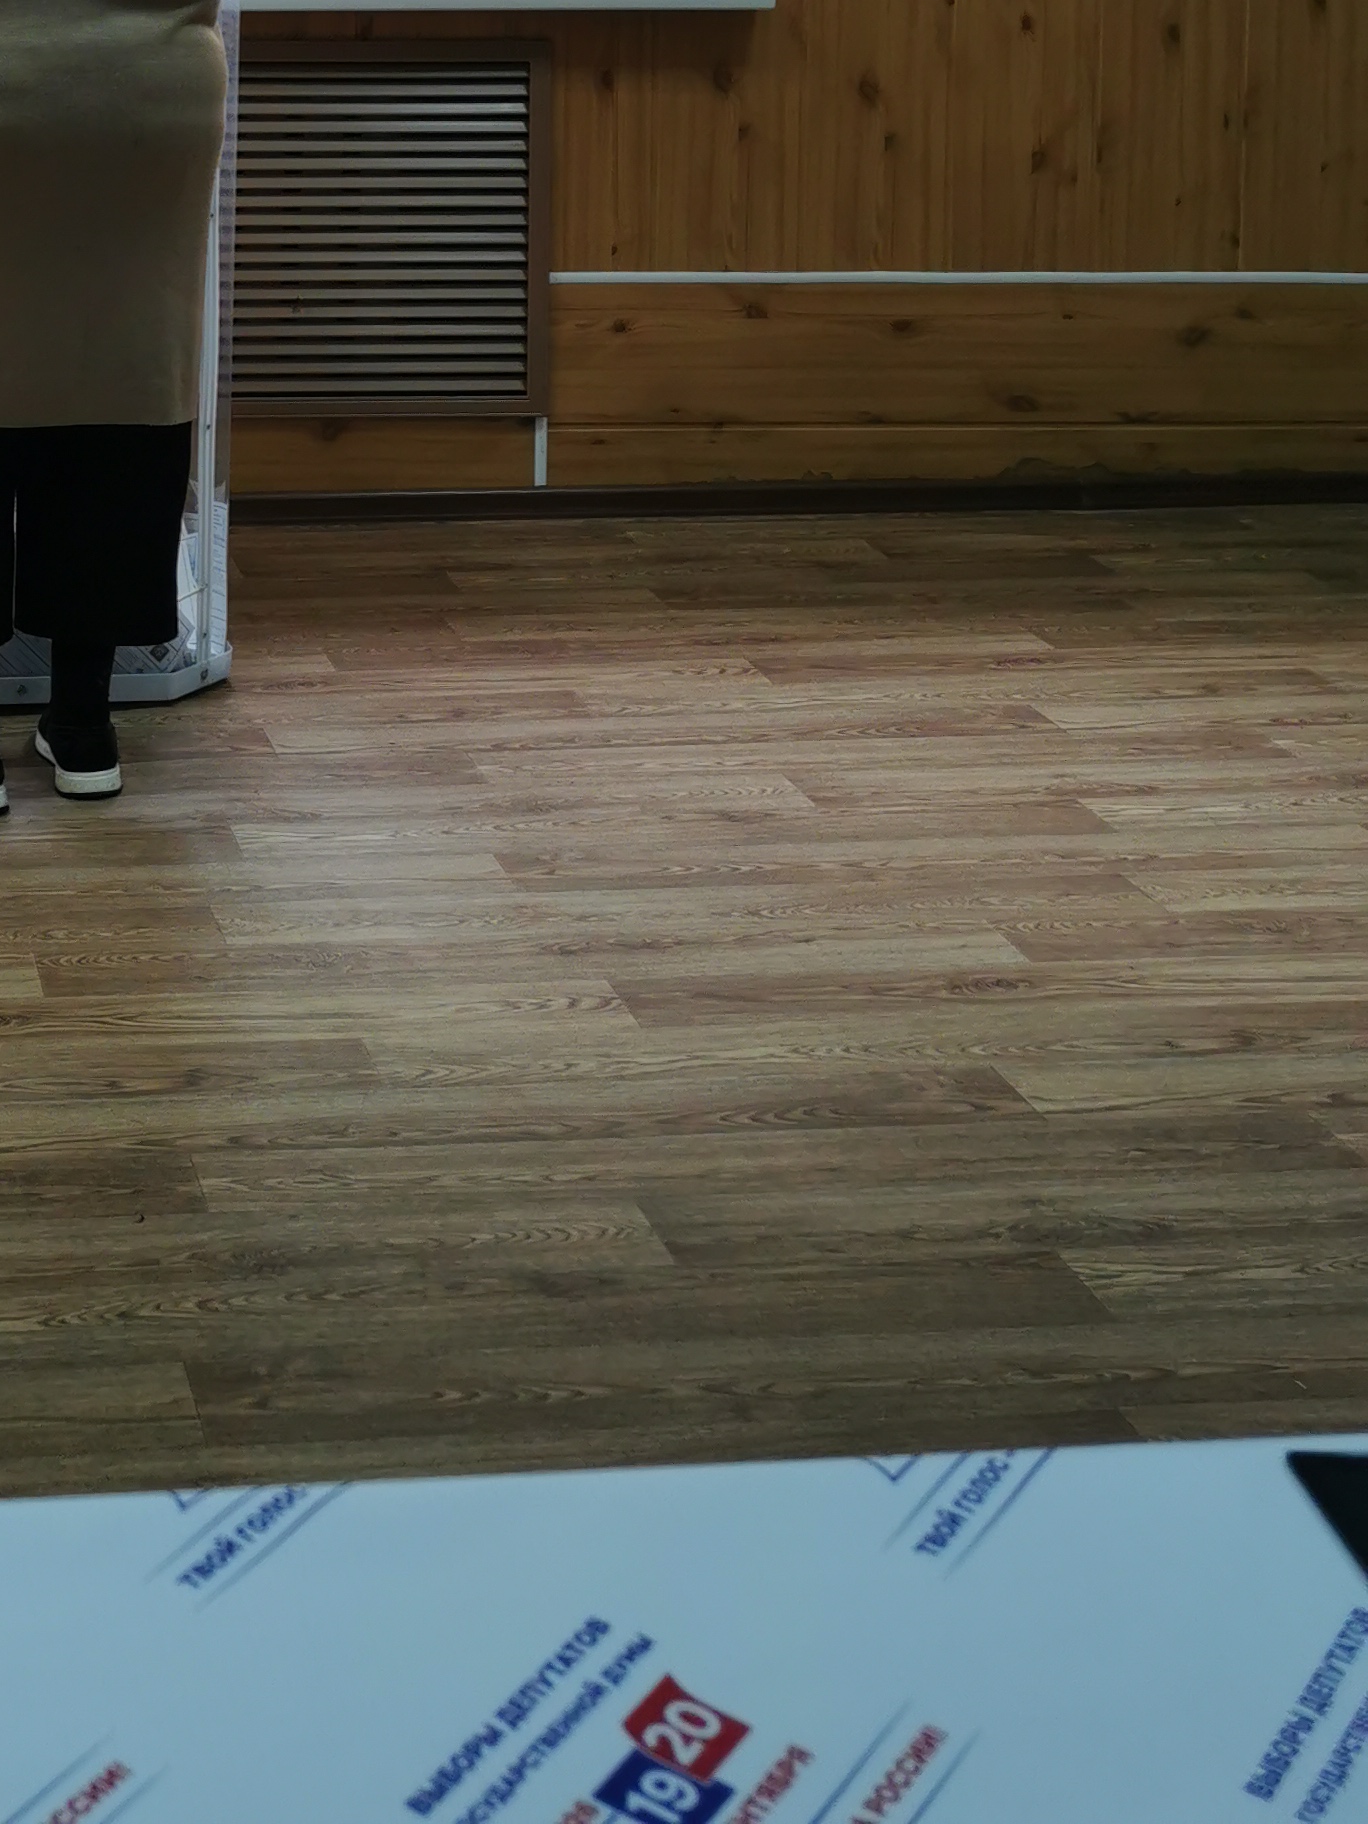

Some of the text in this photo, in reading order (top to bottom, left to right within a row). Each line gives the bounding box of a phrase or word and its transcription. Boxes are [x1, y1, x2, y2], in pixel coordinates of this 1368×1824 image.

[176, 1534, 244, 1589] ТВОЙ
[911, 1509, 968, 1557] ТВОЙ
[404, 1615, 611, 1817] ВЫБОРЫ ДЕПУТАТОВ
[642, 1700, 722, 1766] 20
[1243, 1709, 1316, 1803] ВЫБОРЫ
[625, 1769, 700, 1824] 19
